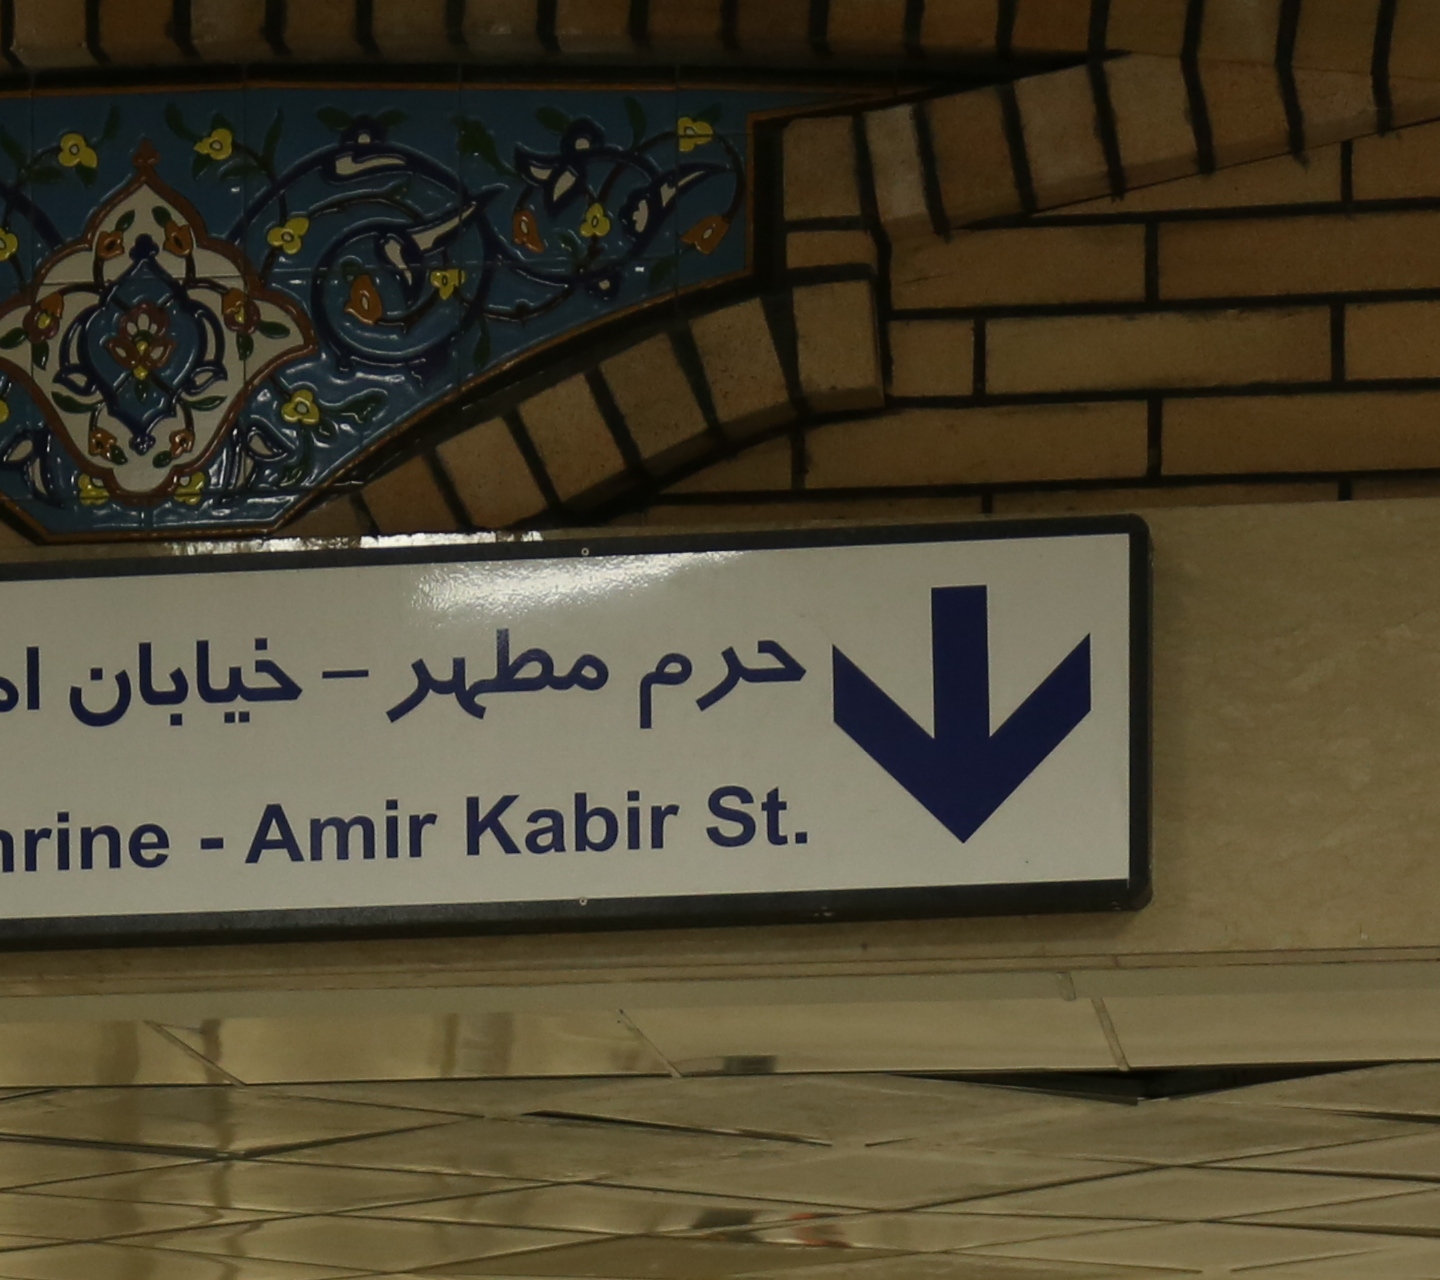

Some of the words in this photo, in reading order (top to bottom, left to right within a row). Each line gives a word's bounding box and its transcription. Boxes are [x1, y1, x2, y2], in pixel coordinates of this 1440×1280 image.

[68, 636, 304, 729] خیابان
[385, 627, 610, 724] مطهر
[638, 639, 808, 731] حرم
[244, 798, 439, 865] Amir
[465, 789, 681, 857] Kabir
[705, 784, 809, 849] St.
